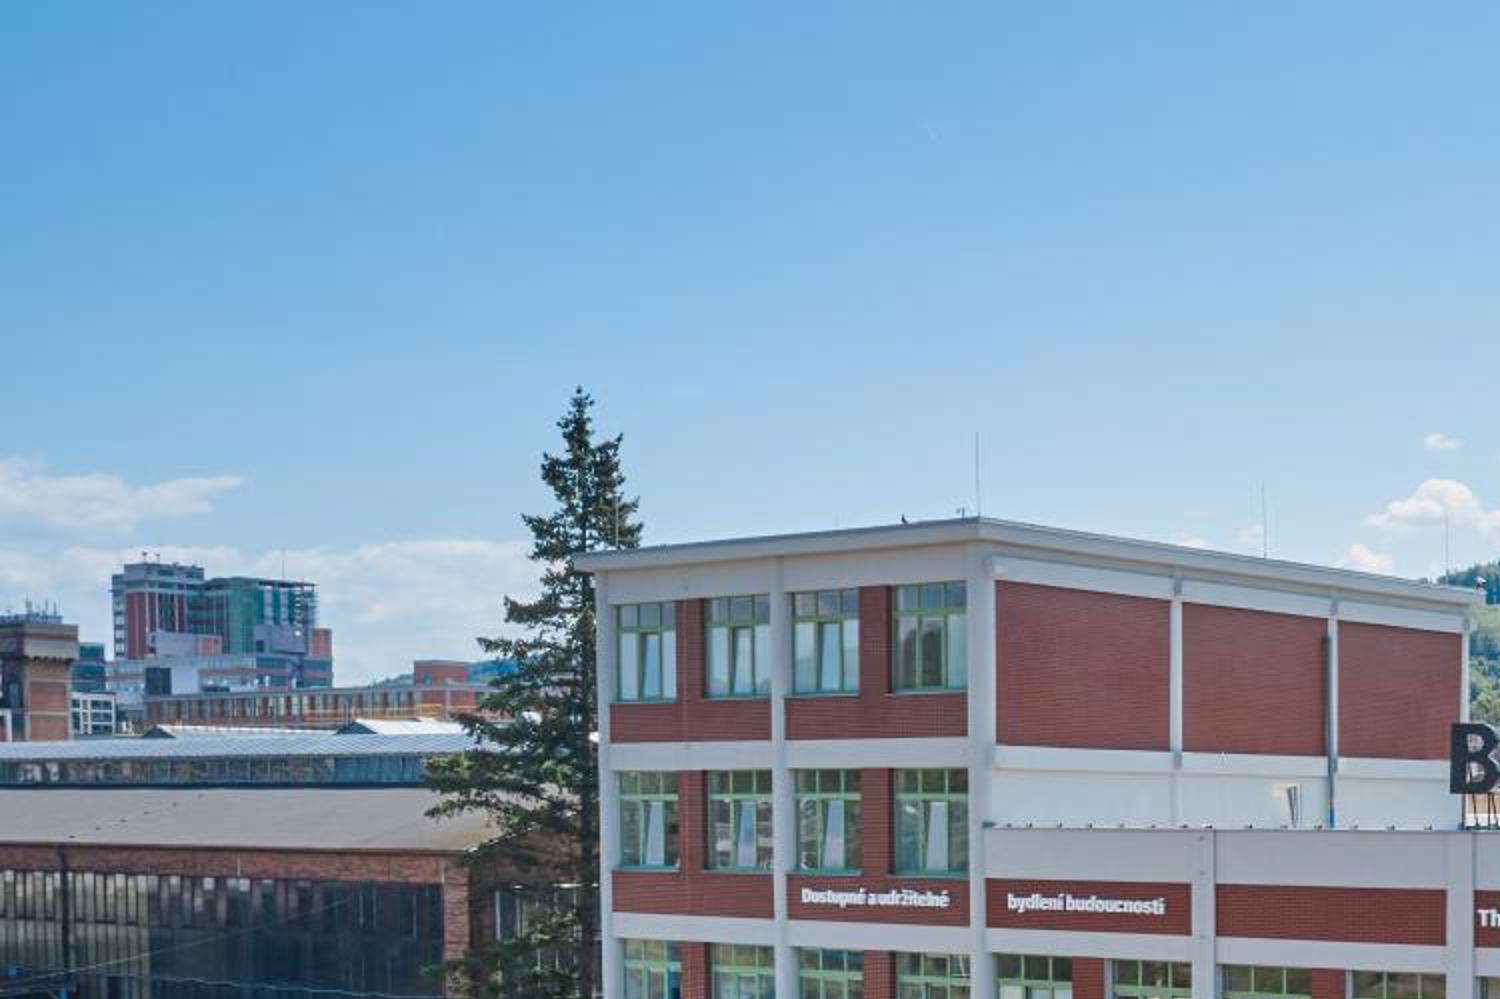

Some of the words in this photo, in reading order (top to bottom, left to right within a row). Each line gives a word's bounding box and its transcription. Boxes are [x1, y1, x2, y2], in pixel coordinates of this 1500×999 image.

[801, 887, 865, 907] Dostupné
[879, 888, 950, 908] udržitelné
[1007, 892, 1063, 914] bydlení
[1066, 895, 1165, 915] budoucnosti
